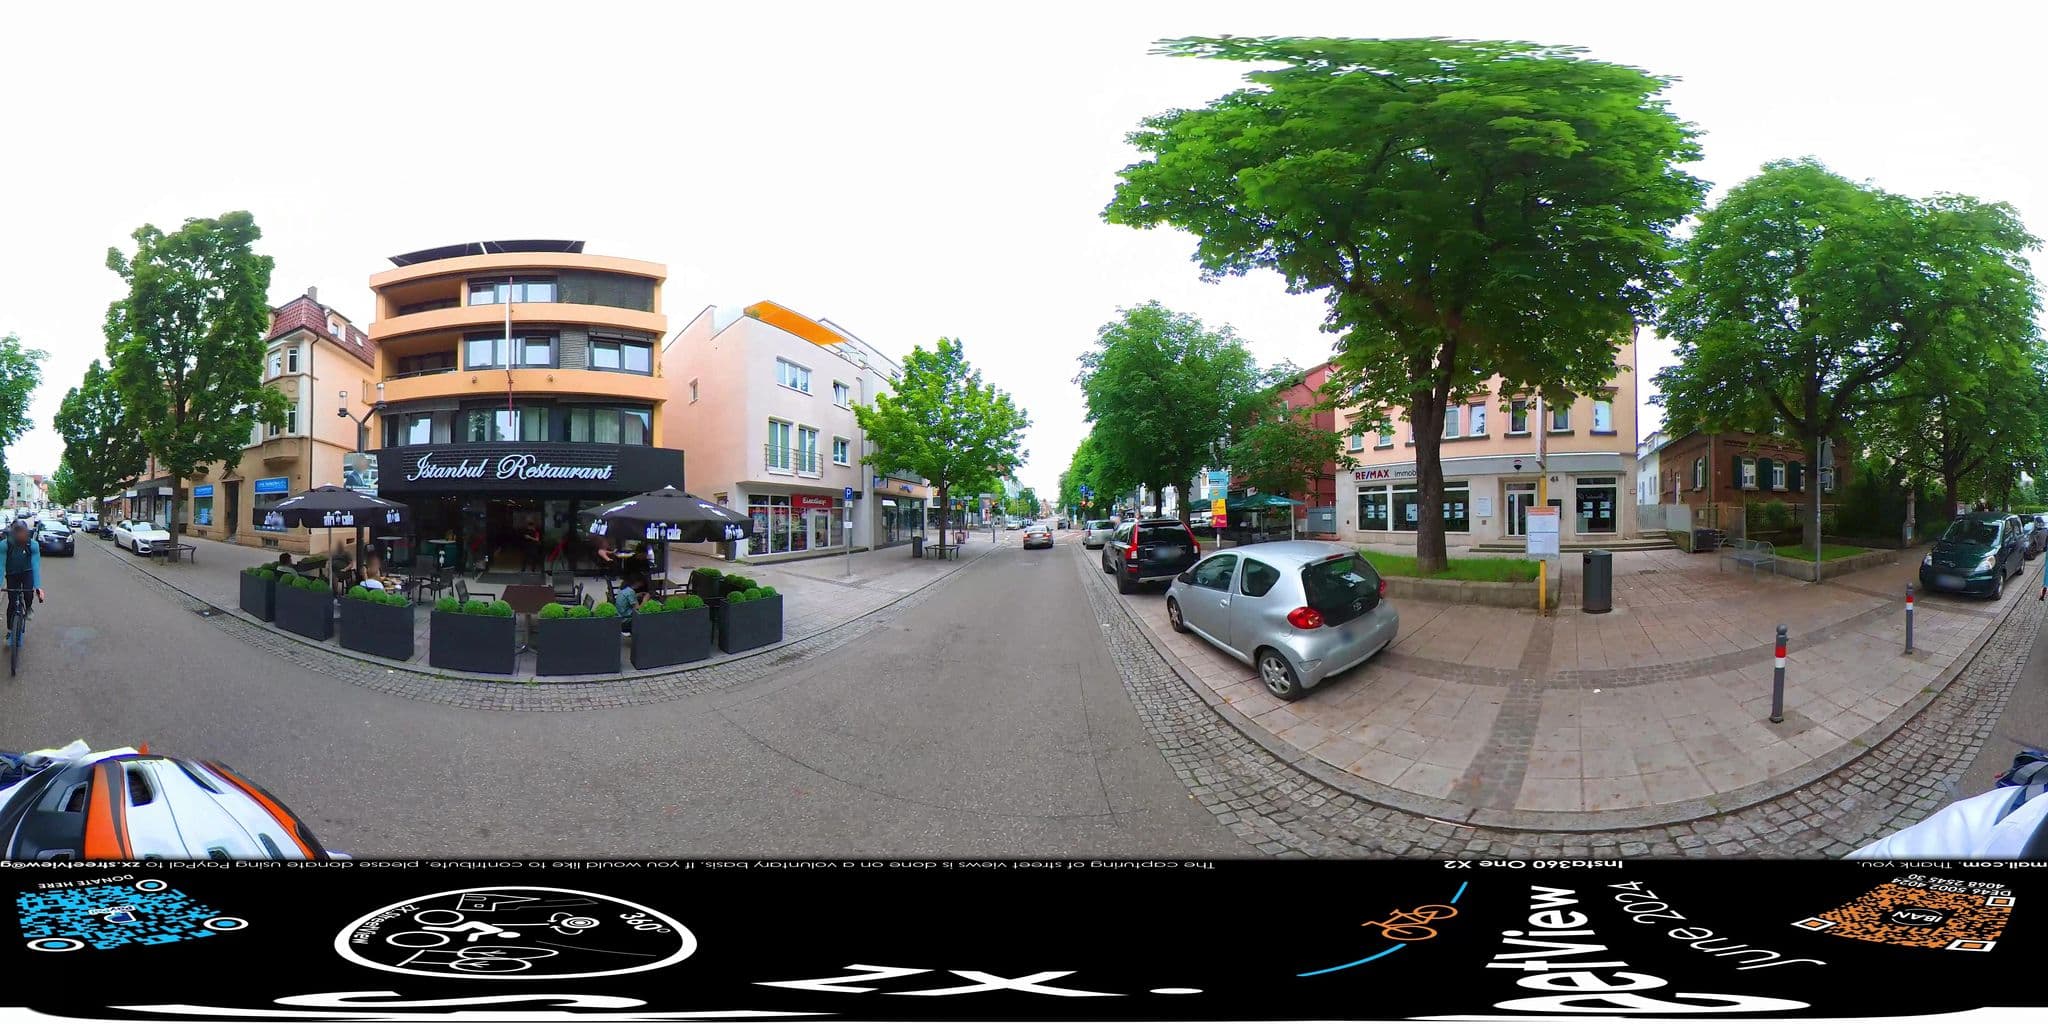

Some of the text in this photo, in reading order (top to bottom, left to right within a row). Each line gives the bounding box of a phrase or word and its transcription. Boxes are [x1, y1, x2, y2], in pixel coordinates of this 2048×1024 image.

[406, 452, 612, 482] Istanbul Restaurant
[1355, 469, 1390, 480] RE/MAX
